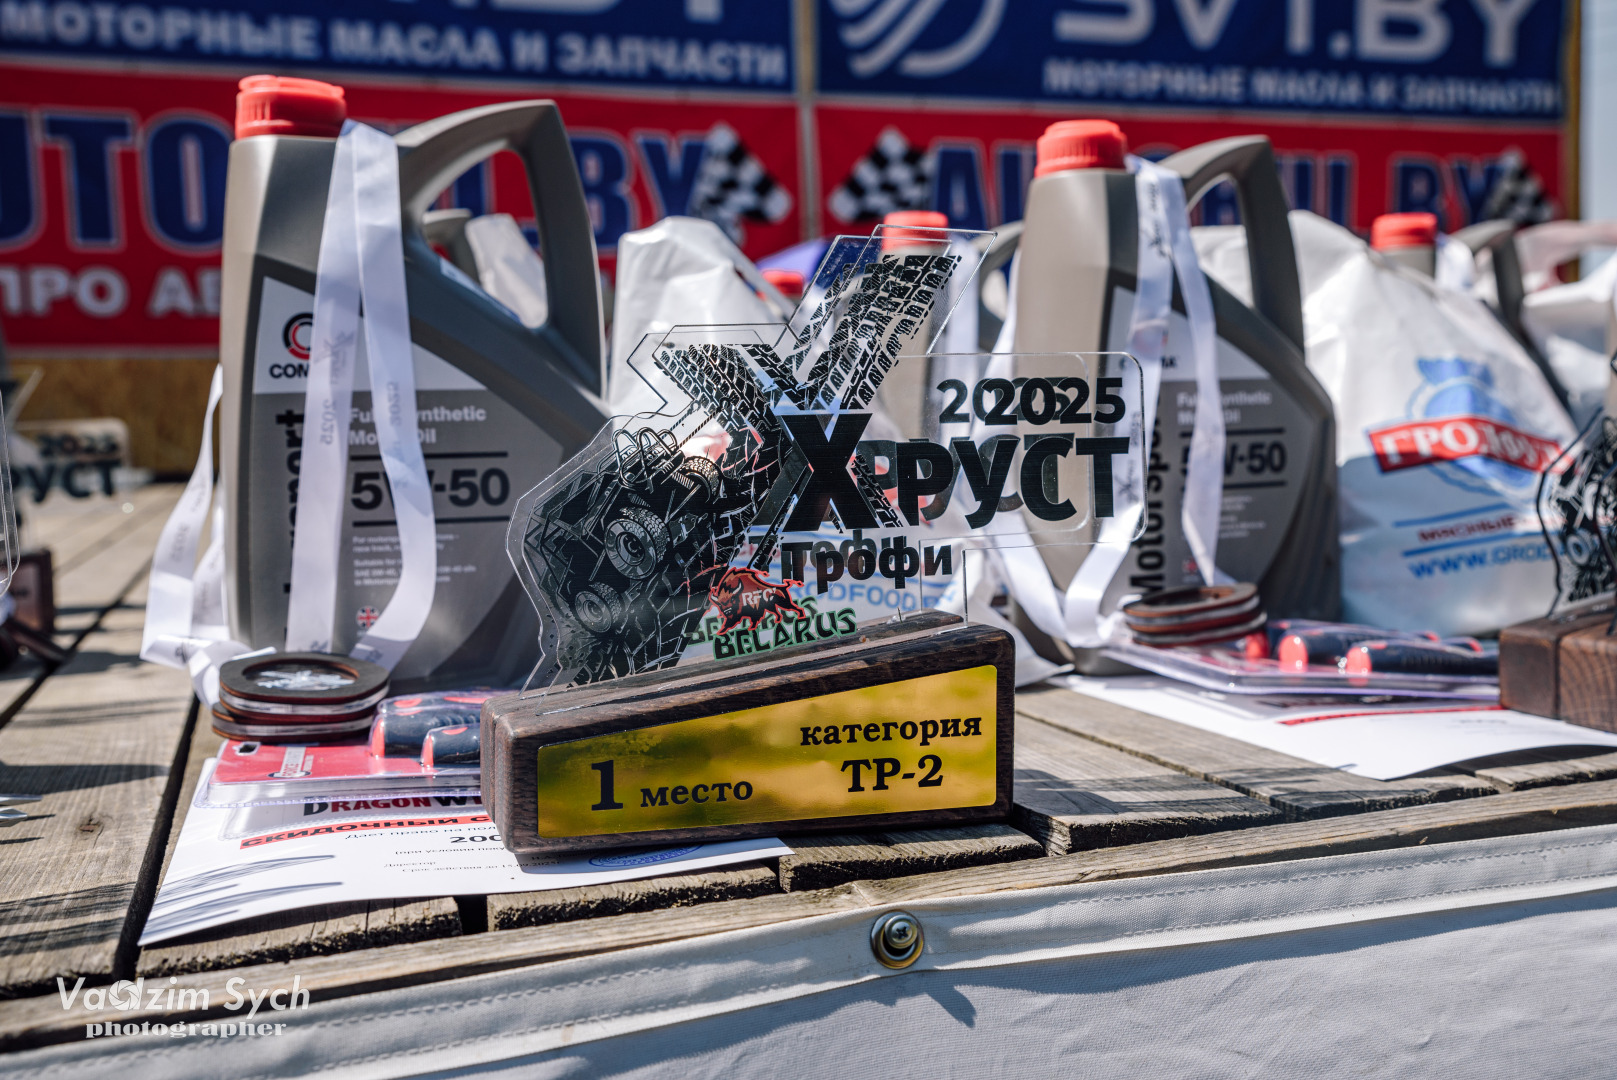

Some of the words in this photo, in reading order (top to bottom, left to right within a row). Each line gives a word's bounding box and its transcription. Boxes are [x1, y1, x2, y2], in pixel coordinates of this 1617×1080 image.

[1, 4, 320, 59] МОТОРНЫЕ
[330, 20, 500, 70] МАСЛА
[511, 31, 547, 72] И
[556, 33, 787, 83] ЗАПЧАСТИ
[981, 377, 1126, 426] 2025
[714, 608, 857, 661] BELARUS
[801, 716, 982, 747] категория
[303, 795, 482, 817] DRAGONWI
[590, 759, 624, 811] 1
[640, 781, 754, 808] место
[241, 816, 459, 848] СКИДОЧНЫЙ
